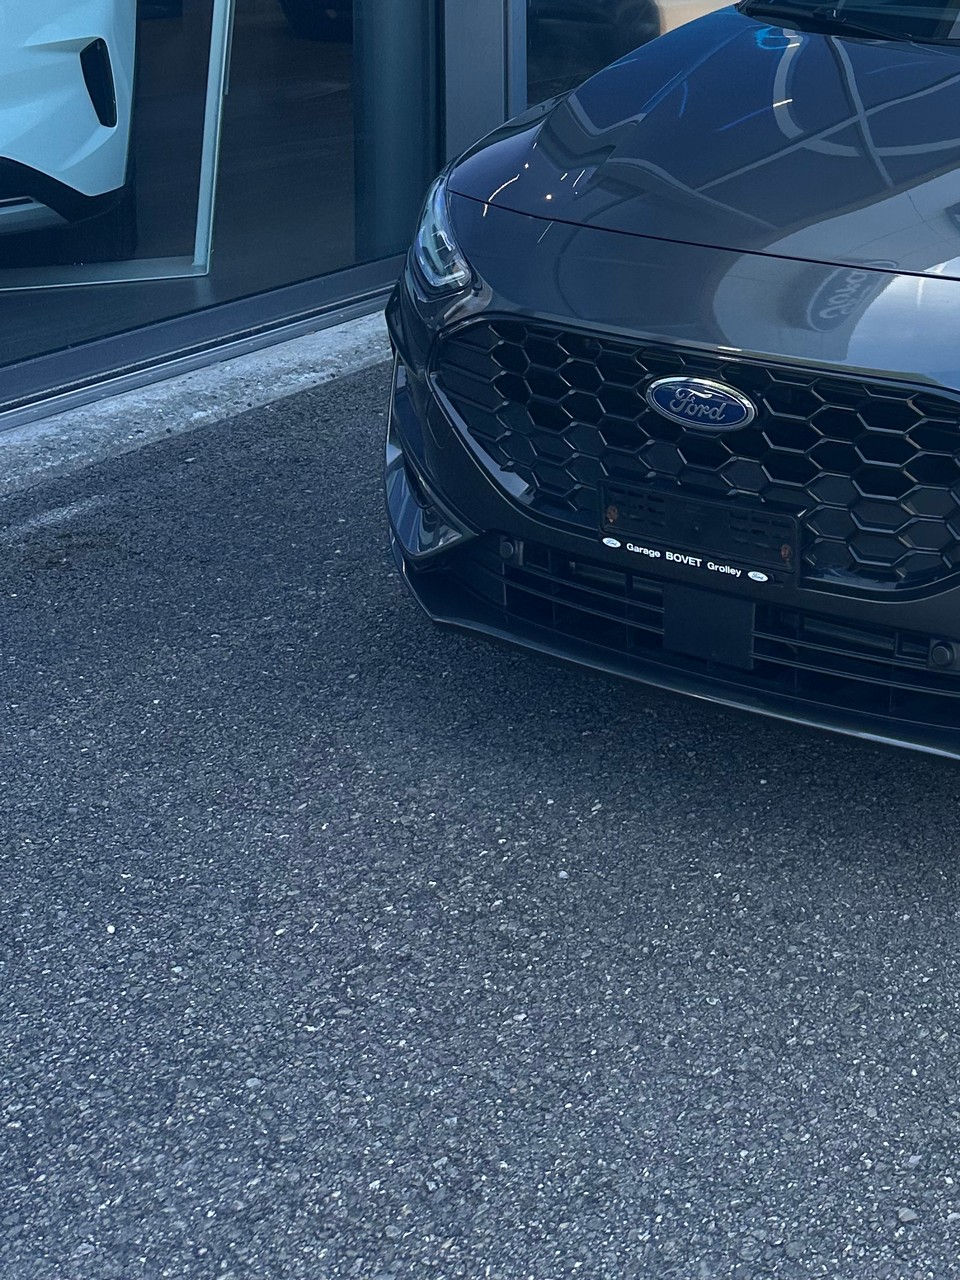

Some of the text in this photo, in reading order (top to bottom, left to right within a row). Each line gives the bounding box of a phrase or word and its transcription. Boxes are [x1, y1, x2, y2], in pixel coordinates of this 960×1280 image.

[669, 387, 727, 421] Ford
[626, 542, 661, 558] Garage
[665, 551, 702, 567] BOVET
[706, 561, 742, 577] Grolley
